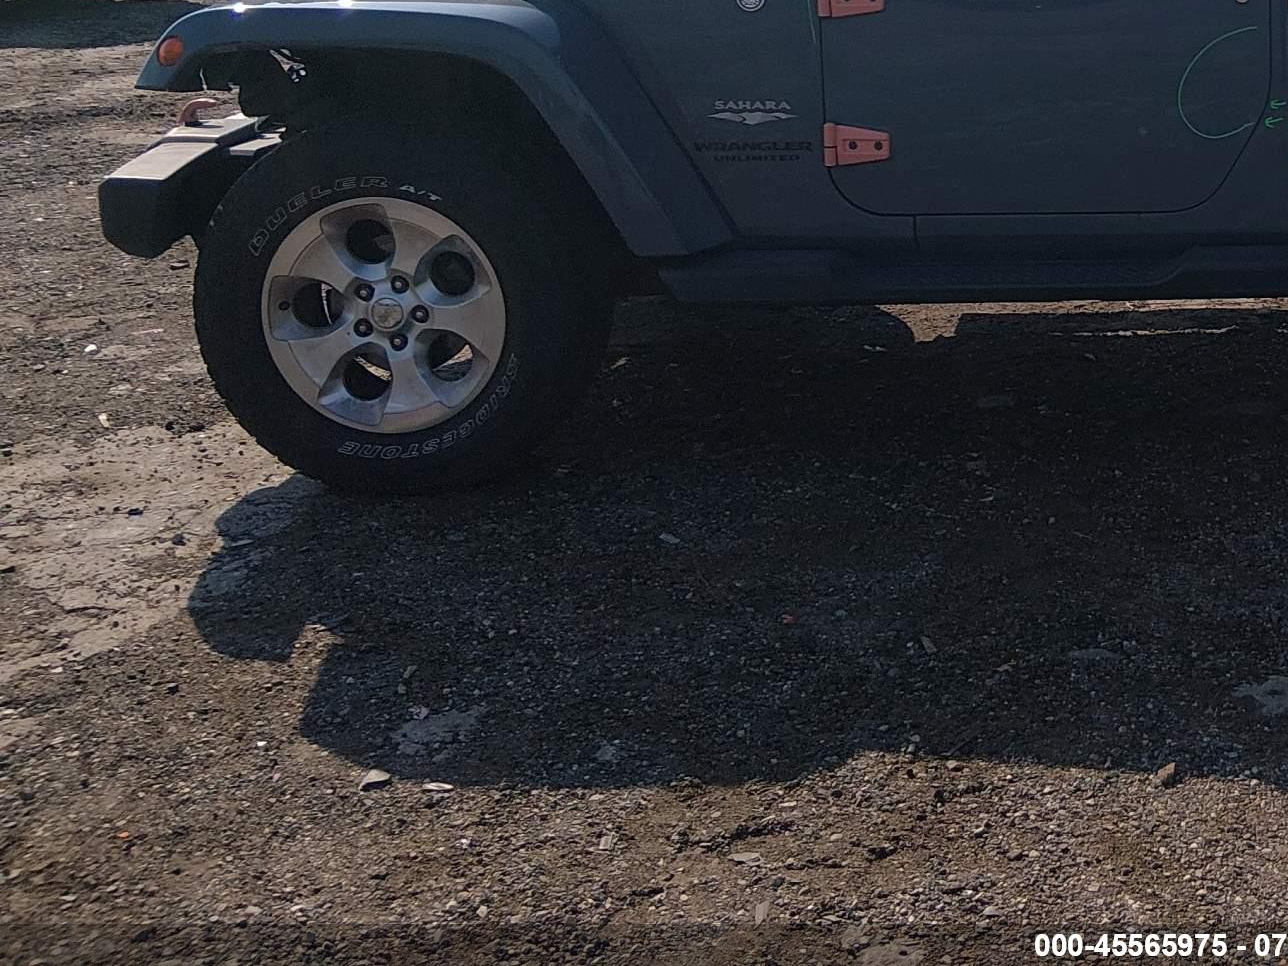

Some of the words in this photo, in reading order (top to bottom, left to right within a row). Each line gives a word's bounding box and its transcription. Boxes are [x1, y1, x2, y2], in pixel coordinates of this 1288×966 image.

[714, 99, 792, 111] SAHARA
[694, 141, 813, 152] WRANGLER
[712, 153, 801, 163] UNLIMITED
[247, 175, 389, 257] DUELER
[398, 183, 443, 202] A/T
[337, 352, 520, 460] BRIDGESTONE
